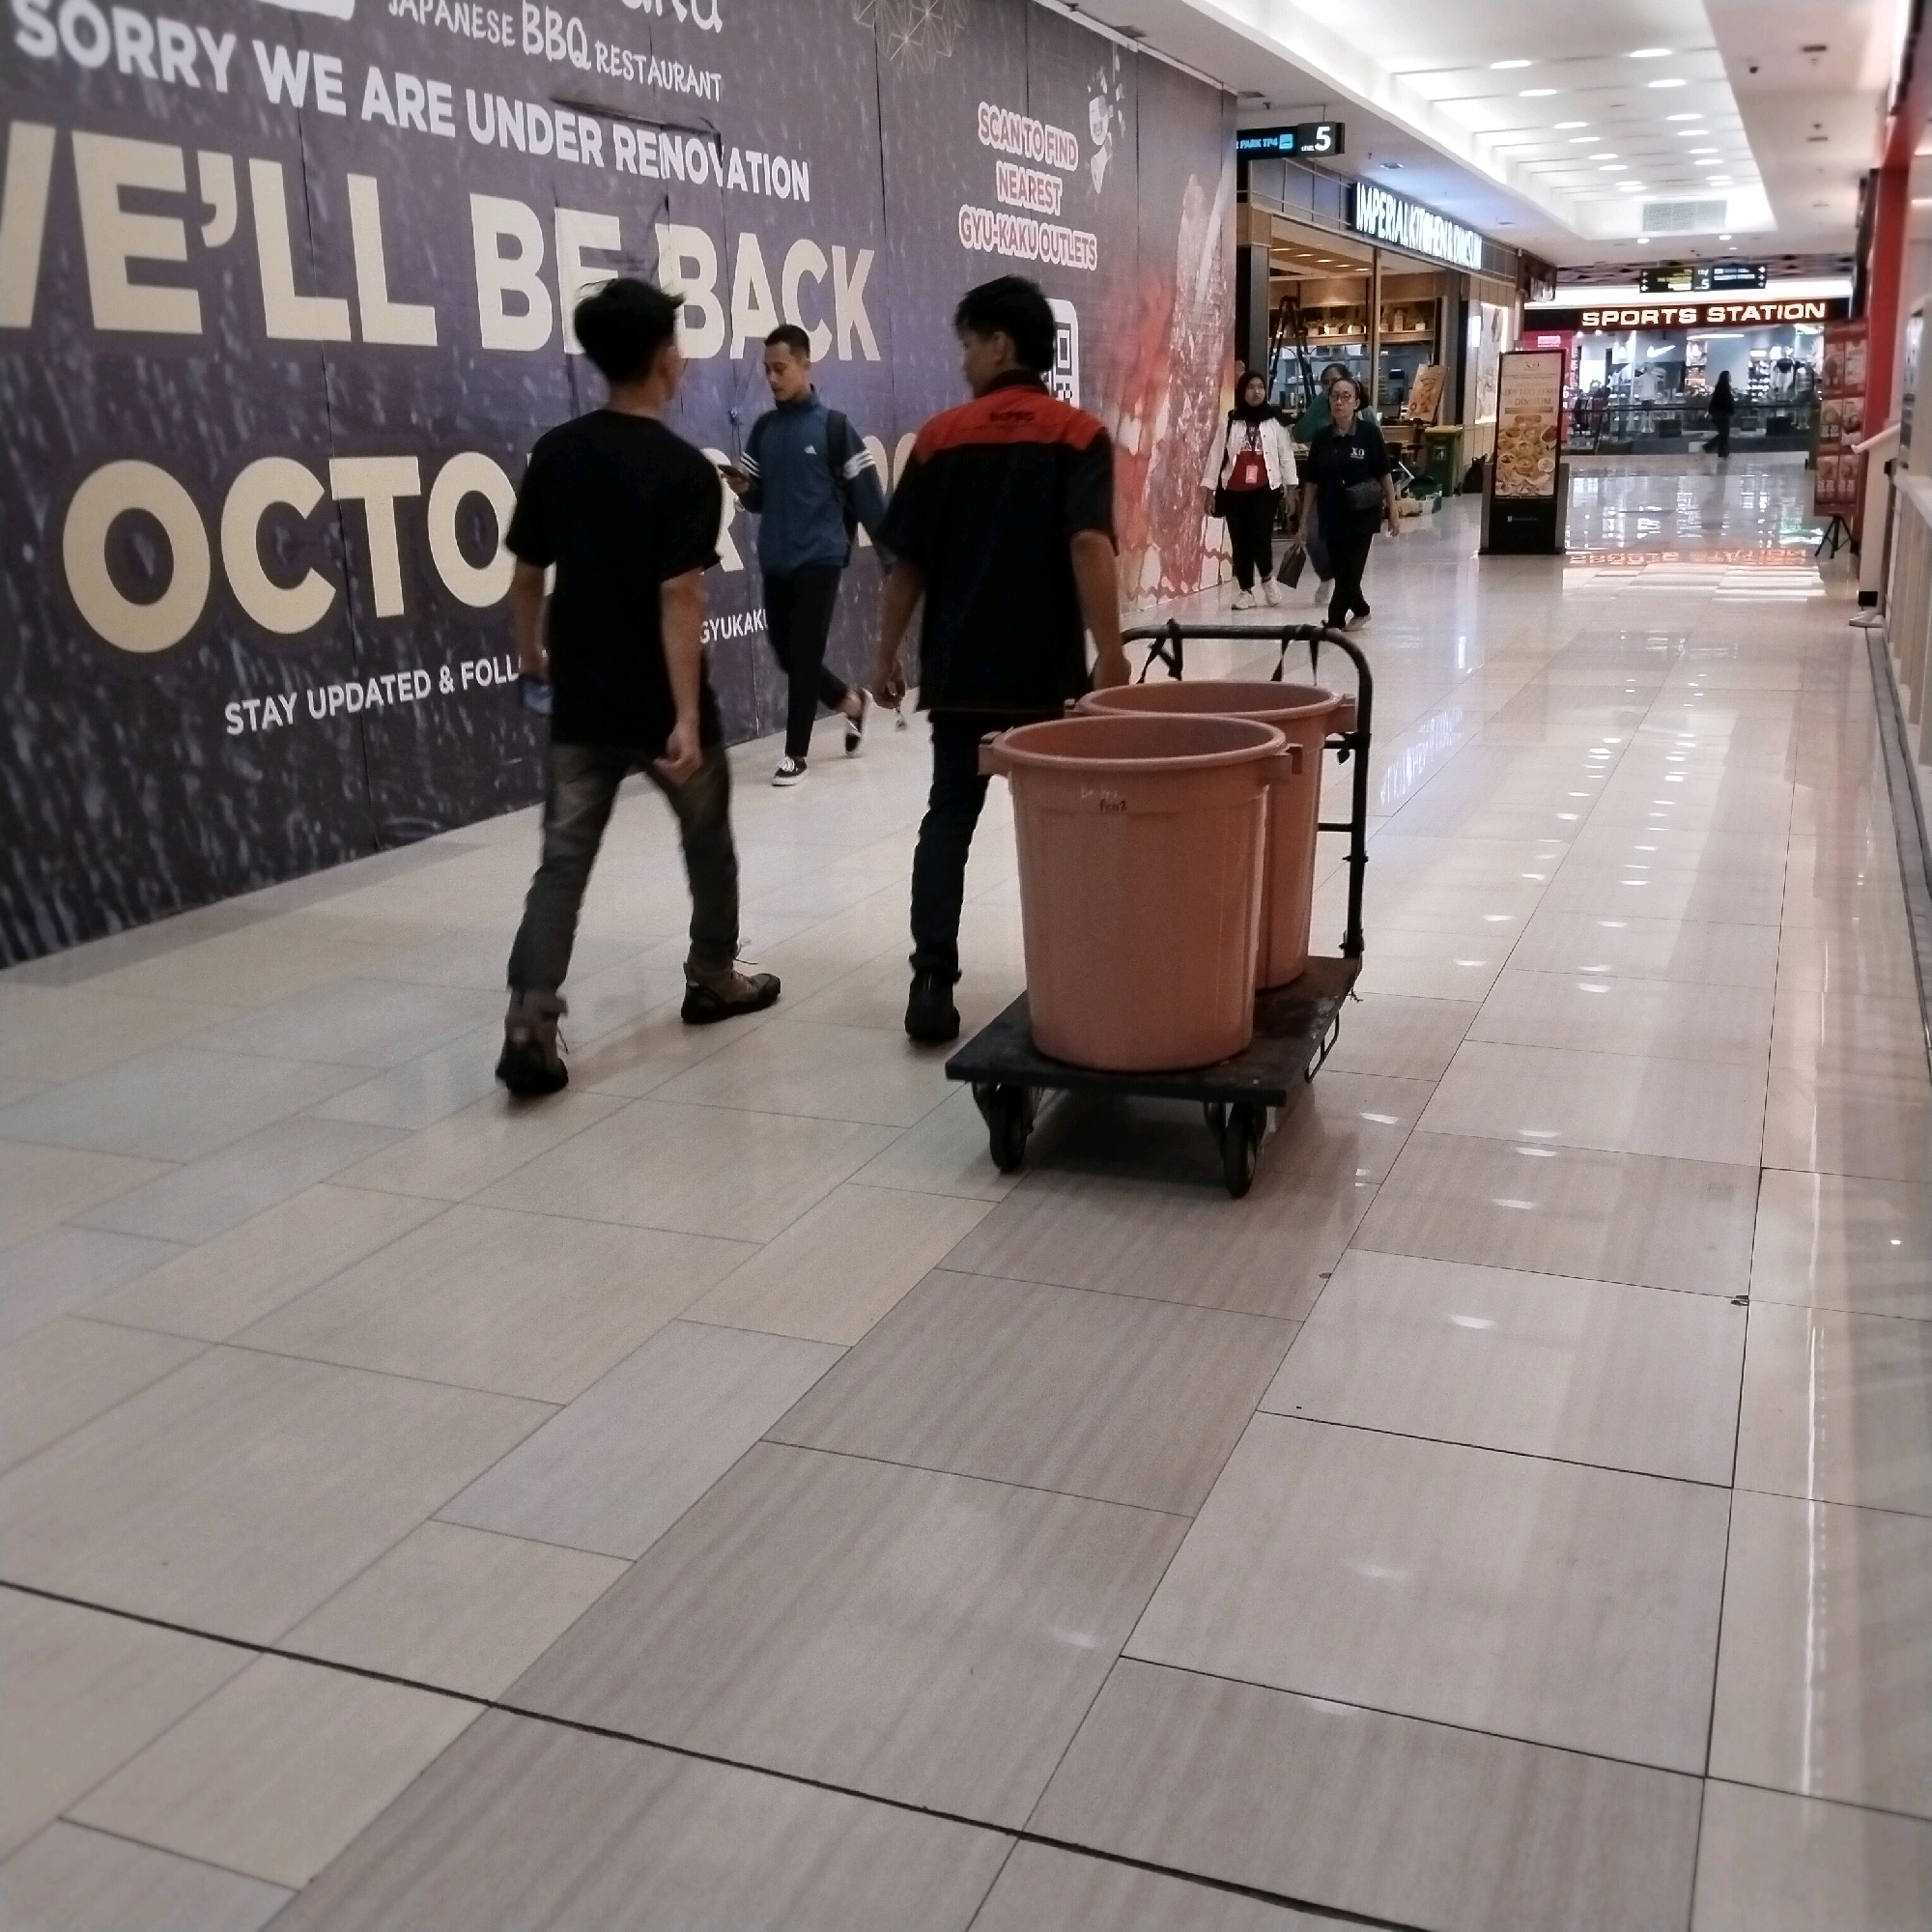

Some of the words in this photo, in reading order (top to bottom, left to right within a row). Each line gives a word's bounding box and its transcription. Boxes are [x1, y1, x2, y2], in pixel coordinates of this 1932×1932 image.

[387, 0, 515, 46] JAPANESE
[522, 1, 591, 71] BBQ
[595, 39, 722, 101] RESTAURANT
[10, 0, 237, 94] SORRY
[251, 39, 347, 117] WE
[361, 63, 456, 137] ARE
[466, 93, 605, 168] UNDER
[612, 124, 811, 203] RENOVATION
[979, 101, 1022, 156] SCAN
[1021, 117, 1044, 162] TO
[1044, 125, 1079, 172] FIND
[1314, 126, 1332, 152] 5
[996, 159, 1063, 216] NEAREST
[1356, 182, 1410, 247] IMPERIAL
[958, 204, 1039, 260] GYU-KAKU
[1038, 222, 1097, 270] OUTLETS
[469, 193, 622, 354] BE
[654, 223, 881, 361] BACK
[1581, 308, 1698, 327] SPORTS
[1706, 302, 1826, 323] STATION
[224, 690, 298, 735] STAY
[306, 668, 431, 720] UPDATED
[439, 665, 455, 695] &
[460, 654, 522, 691] FOLL
